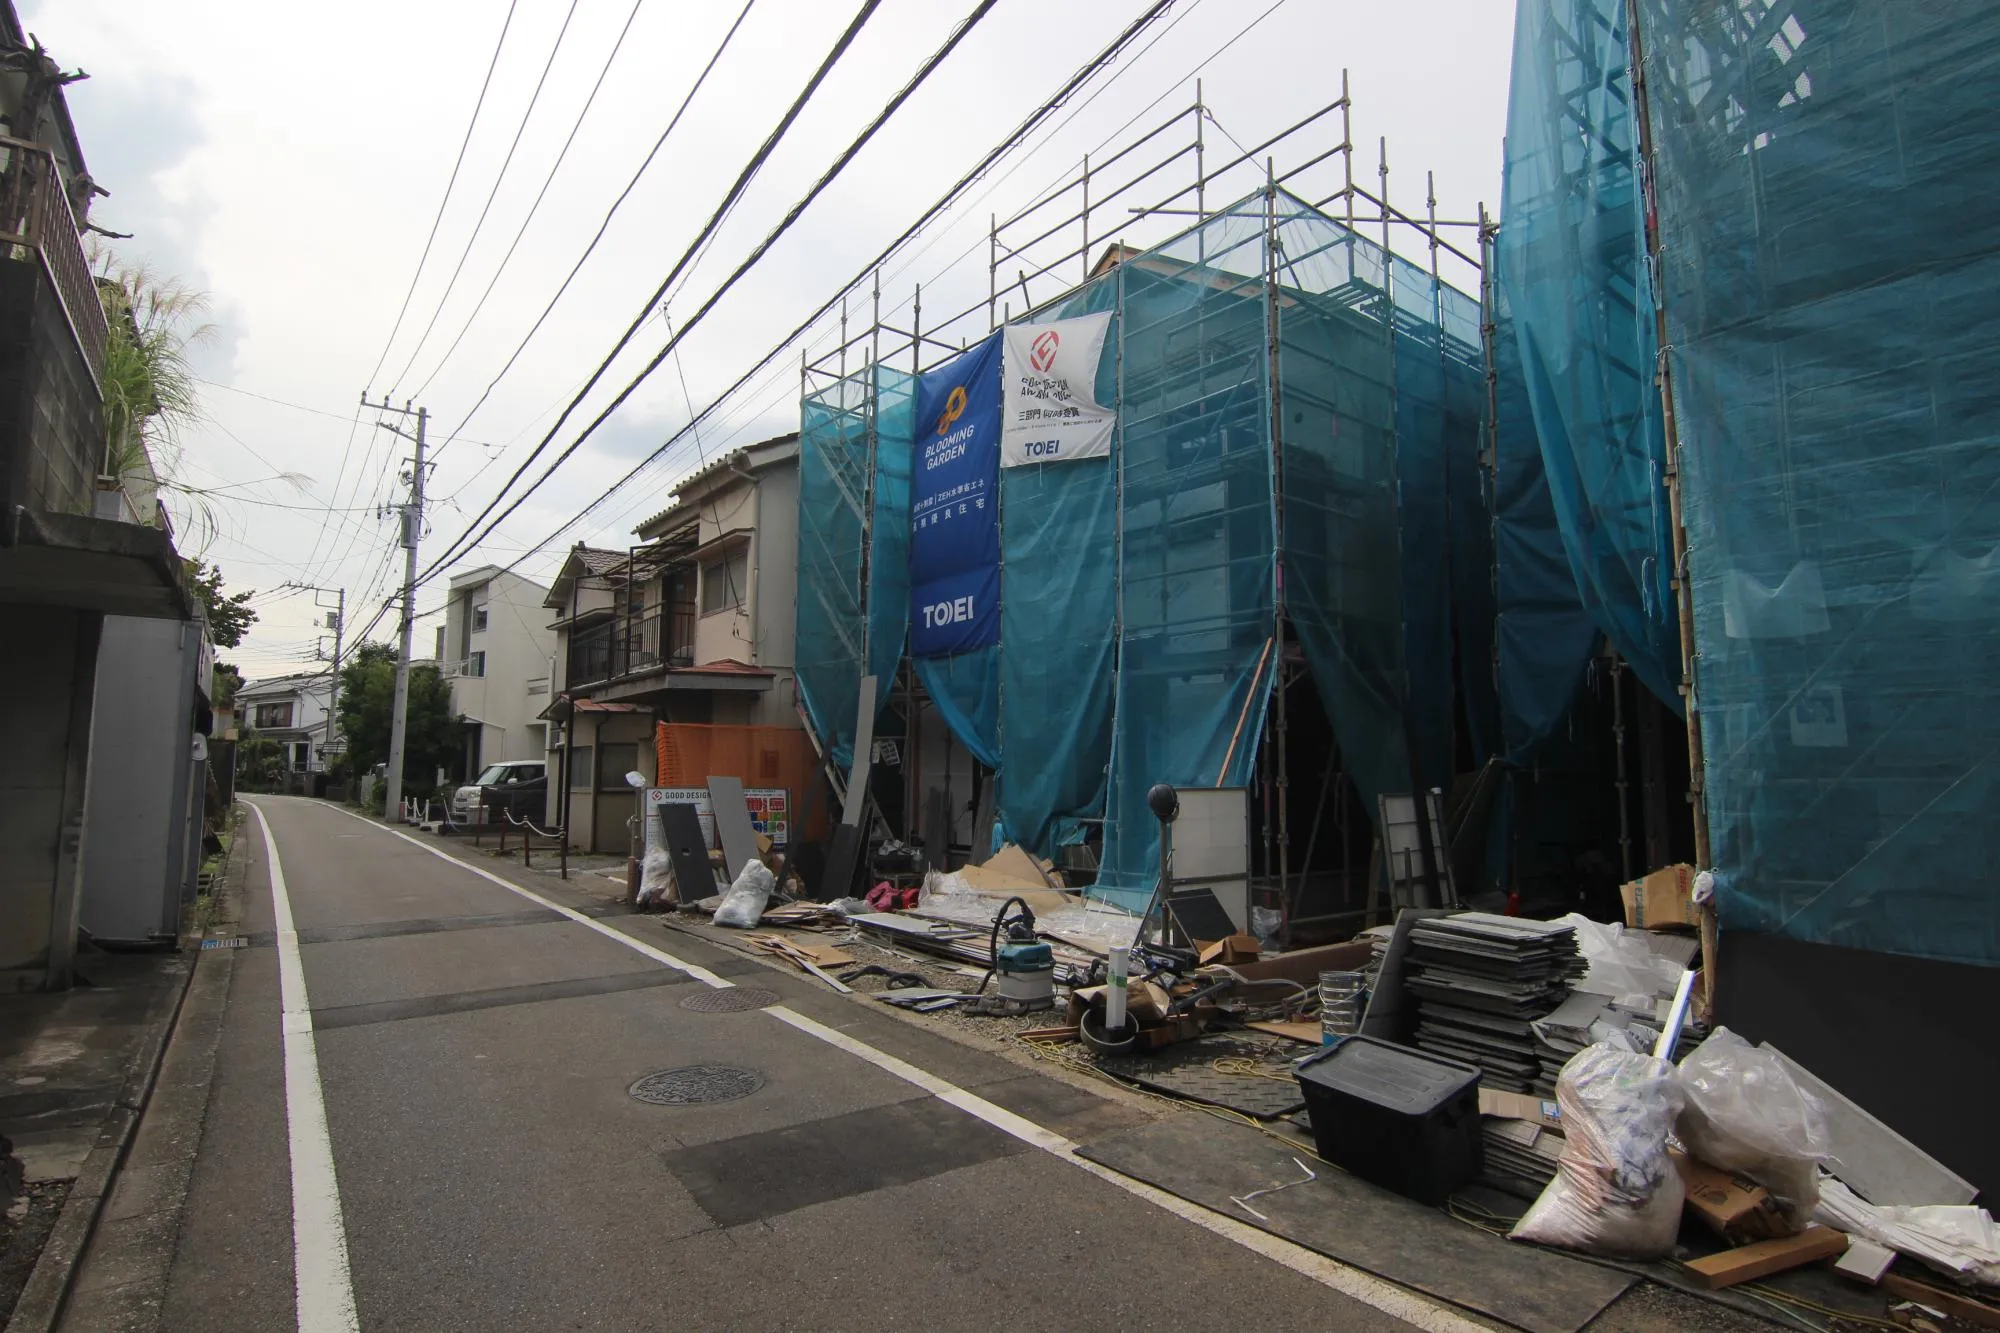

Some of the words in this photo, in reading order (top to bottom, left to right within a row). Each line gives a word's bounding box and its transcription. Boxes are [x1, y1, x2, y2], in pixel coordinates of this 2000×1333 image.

[1018, 408, 1041, 421] 三部門
[925, 424, 975, 458] BLOOMING
[1024, 440, 1060, 457] TOEI
[927, 442, 966, 471] GARDEN
[922, 595, 974, 629] TOEI
[665, 791, 685, 799] GOOD
[686, 791, 712, 799] DESIGN
